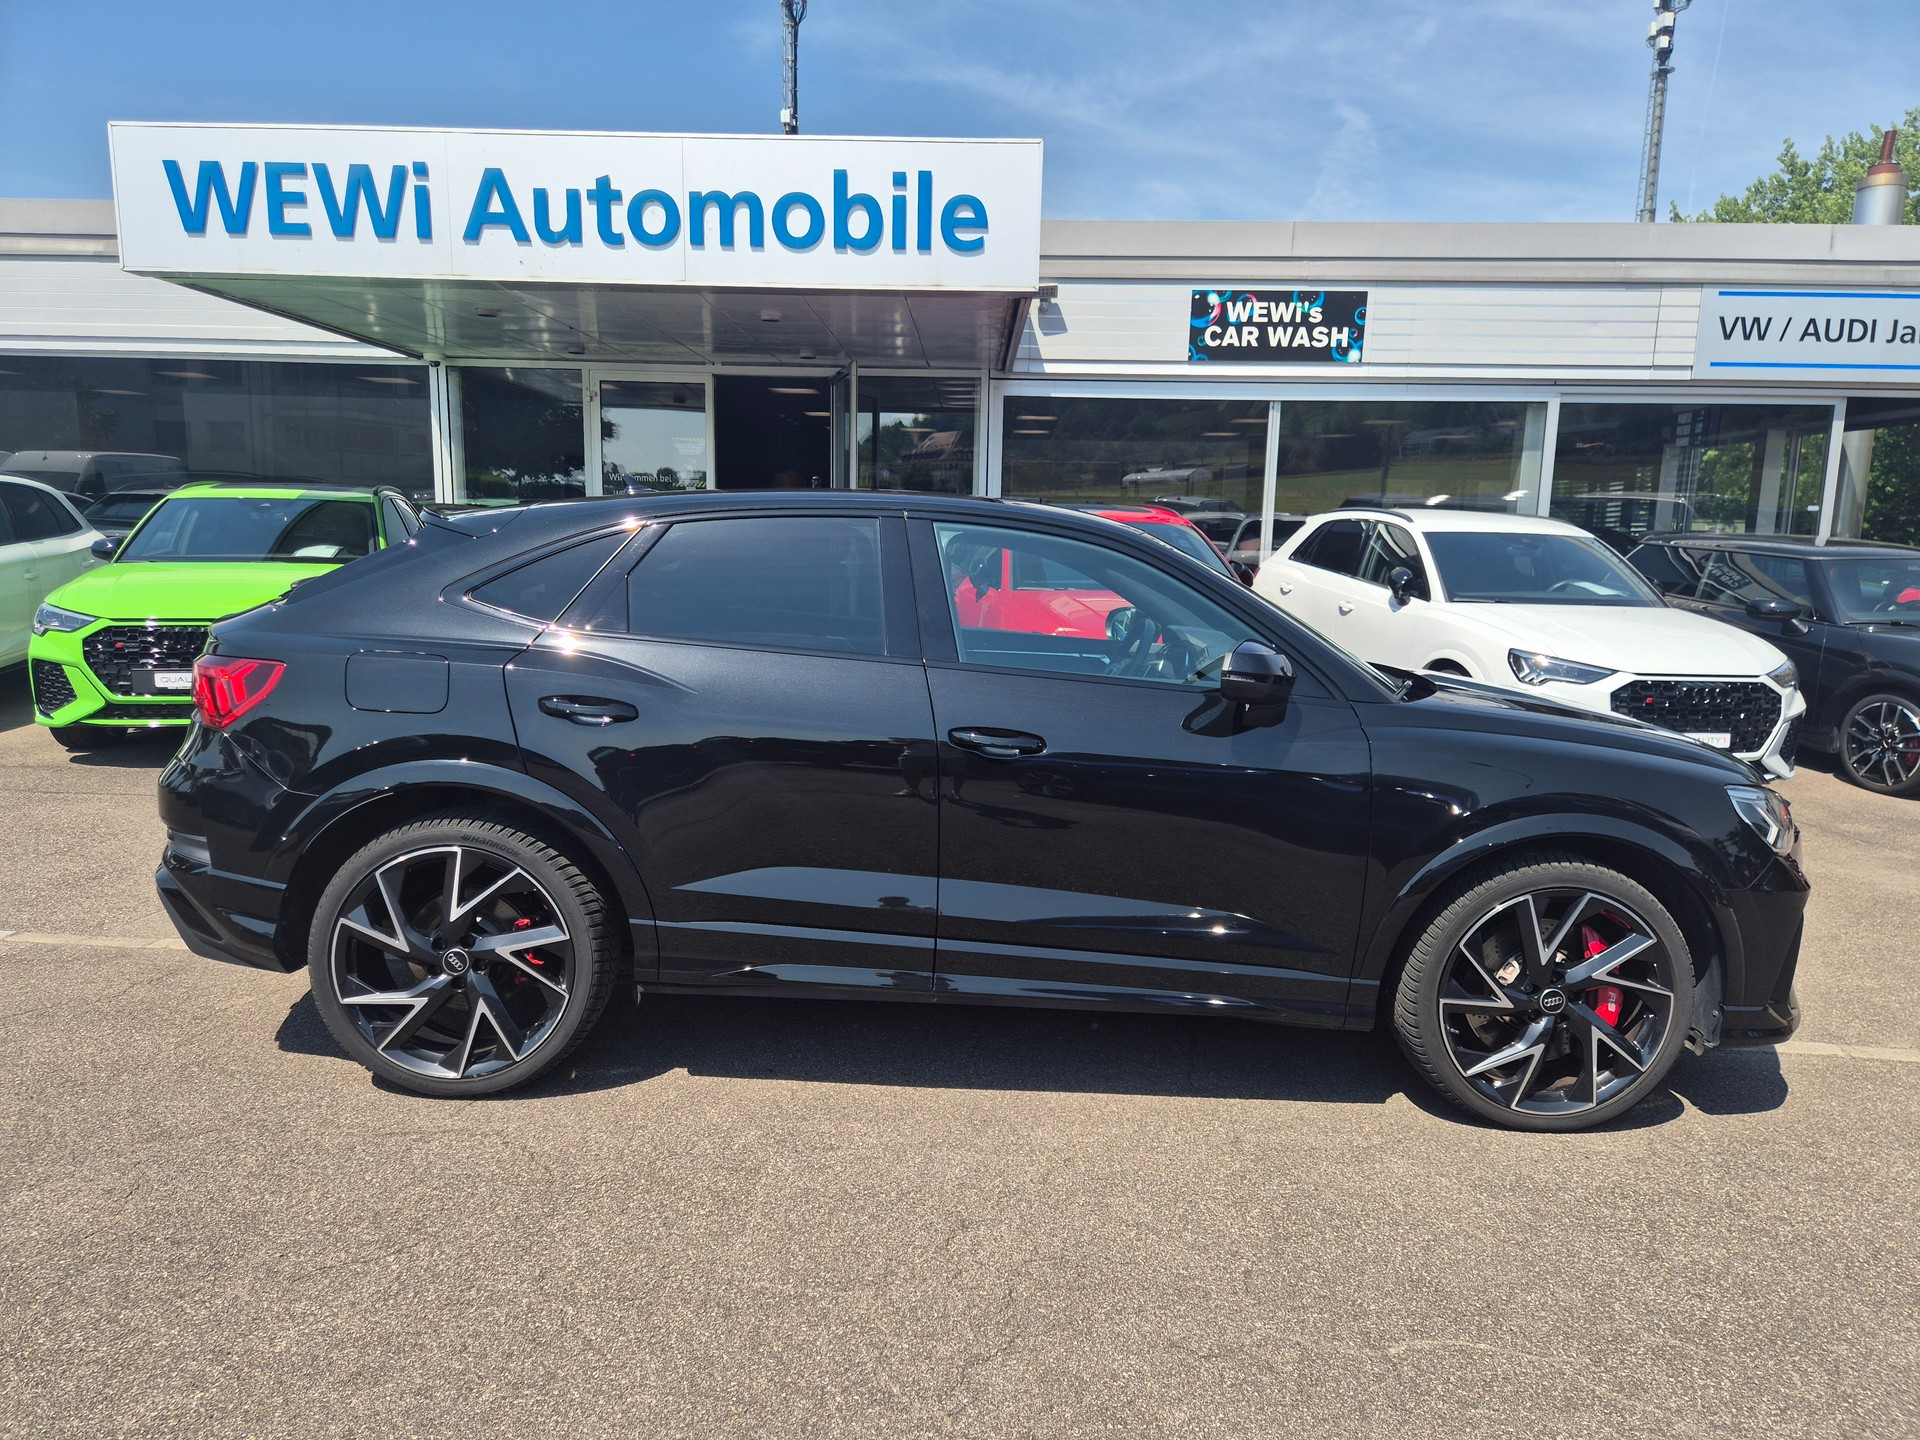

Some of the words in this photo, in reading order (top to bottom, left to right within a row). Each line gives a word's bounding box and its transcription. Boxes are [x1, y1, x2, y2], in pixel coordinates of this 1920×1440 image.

[163, 160, 431, 238] WEWi
[464, 169, 988, 251] Automobile
[1226, 301, 1323, 324] WEWi's
[1204, 326, 1259, 347] CAR
[1267, 326, 1349, 348] WASH
[1719, 316, 1773, 342] VW
[1779, 317, 1793, 342] /
[1799, 318, 1877, 343] AUDI
[1886, 319, 1920, 345] Ja
